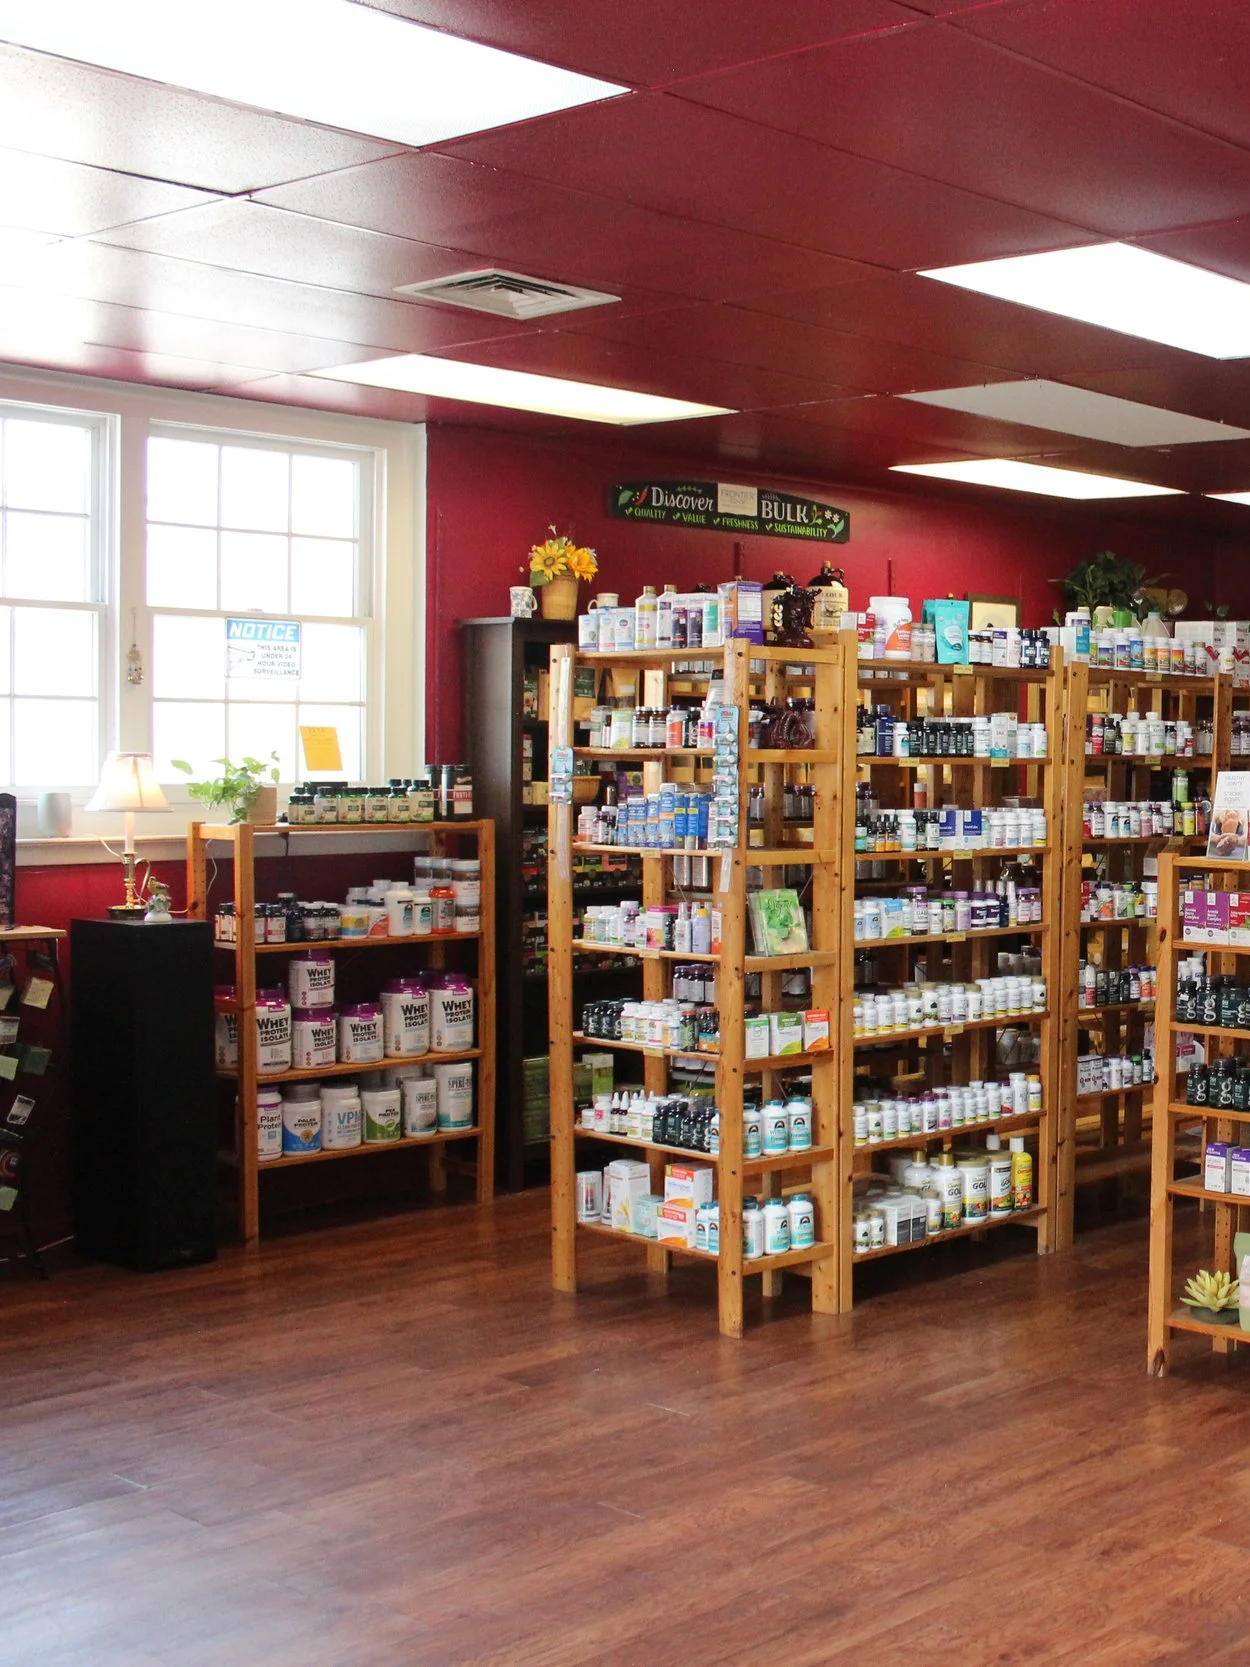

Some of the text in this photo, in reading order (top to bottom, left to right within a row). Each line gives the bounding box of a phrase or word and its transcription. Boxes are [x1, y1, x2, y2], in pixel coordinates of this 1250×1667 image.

[651, 486, 714, 512] Discover
[634, 507, 667, 520] QUALITY
[761, 500, 809, 524] BULK
[682, 512, 707, 525] VALUE
[722, 517, 759, 531] FRESHNESS
[774, 523, 828, 538] SUSTAINABILITY
[229, 622, 297, 641] NOTICE
[254, 668, 300, 676] SURVEILLANCE
[307, 968, 331, 977] WHEY
[442, 1000, 471, 1011] WHEY
[257, 1017, 289, 1030] WHEY
[350, 1022, 377, 1033] WHEY
[311, 1028, 334, 1038] WHEY
[260, 1114, 280, 1123] Plant
[258, 1122, 281, 1130] Protei
[1001, 1179, 1010, 1187] GO
